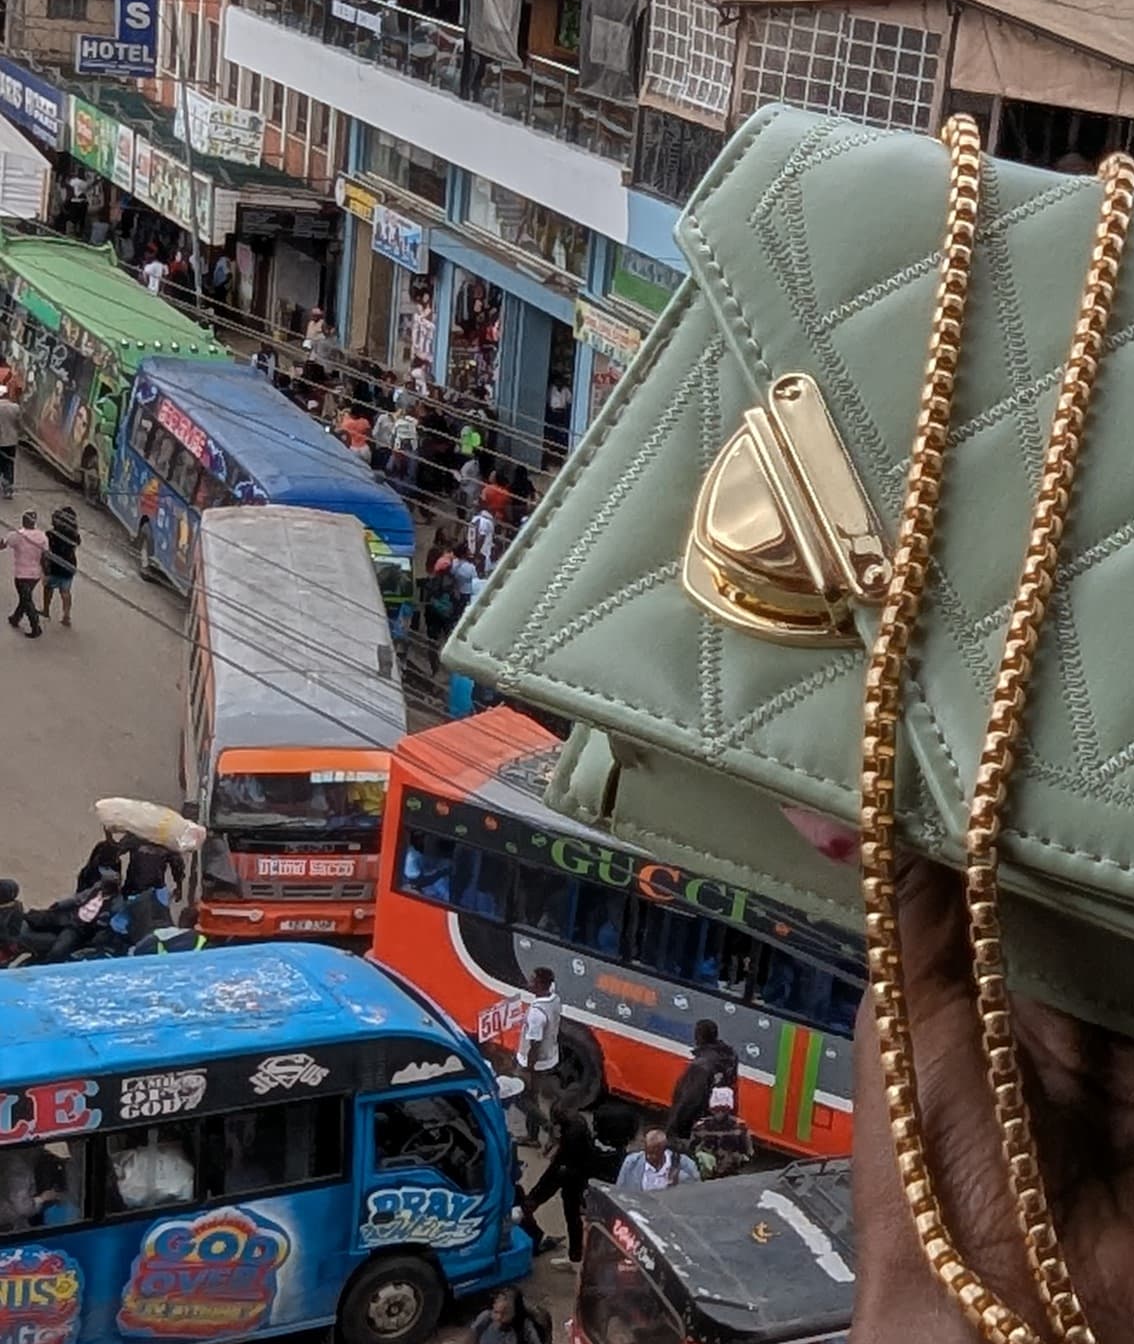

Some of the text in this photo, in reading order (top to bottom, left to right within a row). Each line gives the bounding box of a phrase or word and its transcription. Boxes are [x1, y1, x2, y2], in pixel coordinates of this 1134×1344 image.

[82, 40, 154, 64] HOTEL
[551, 837, 749, 926] GUCCI
[120, 1099, 184, 1119] GOD
[155, 1227, 280, 1262] GOD
